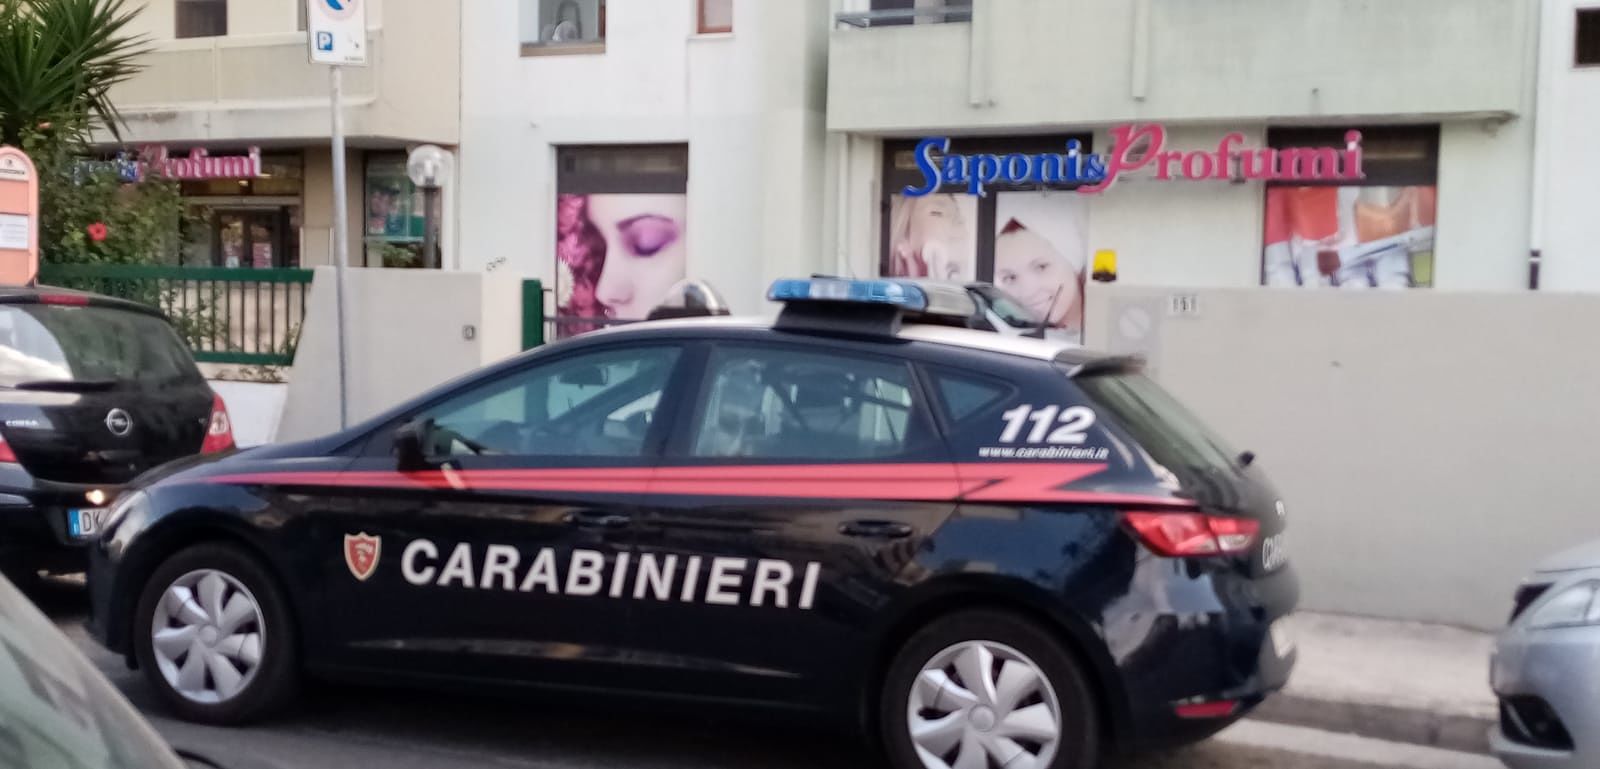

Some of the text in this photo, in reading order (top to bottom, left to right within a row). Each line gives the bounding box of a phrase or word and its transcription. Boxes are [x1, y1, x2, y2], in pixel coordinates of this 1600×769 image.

[1077, 122, 1364, 195] Profumi
[998, 403, 1096, 443] 112
[979, 446, 1109, 460] www.carabinieri.it
[401, 538, 821, 610] CARABINIERI
